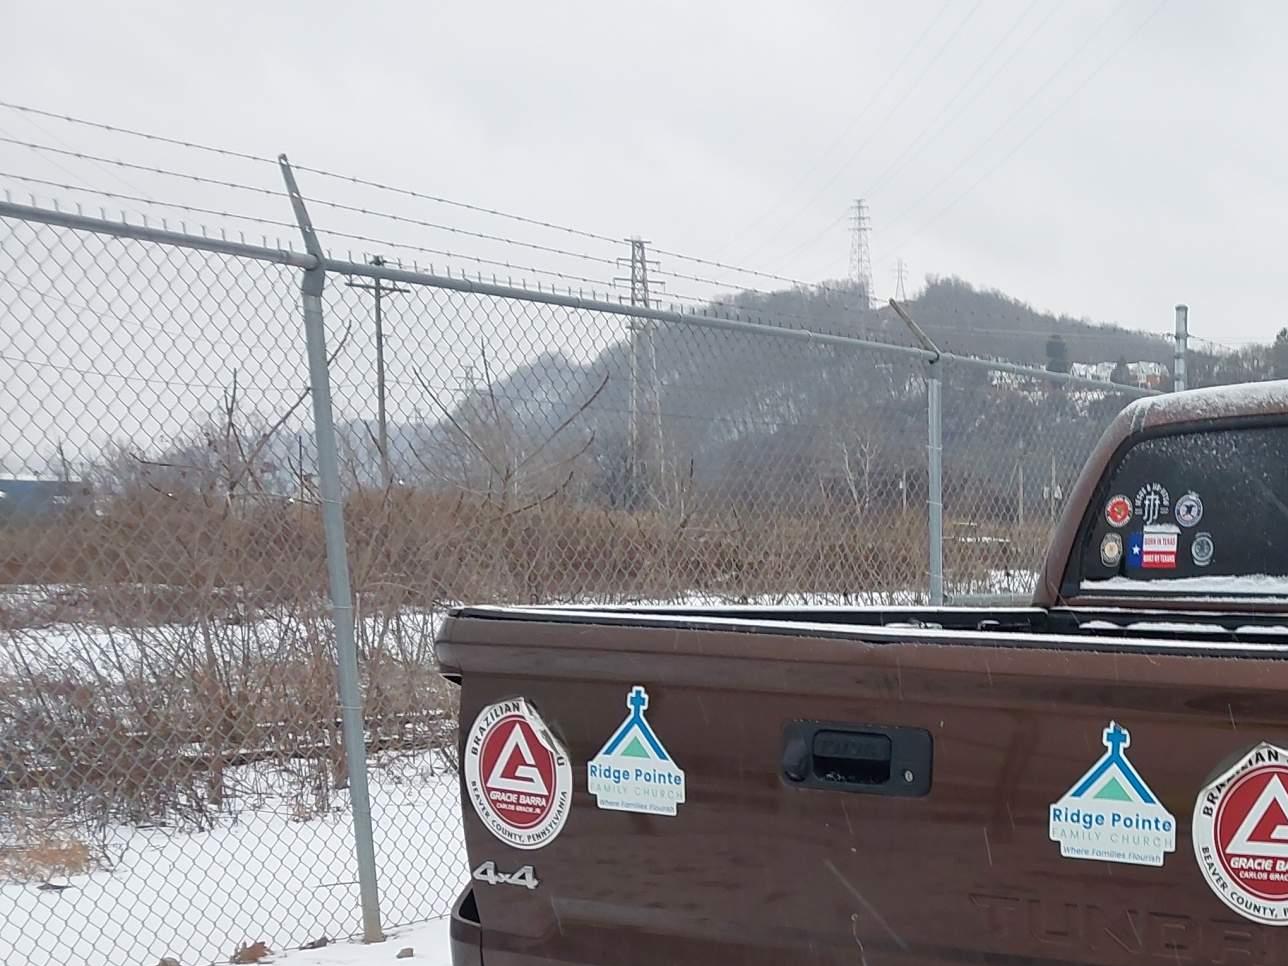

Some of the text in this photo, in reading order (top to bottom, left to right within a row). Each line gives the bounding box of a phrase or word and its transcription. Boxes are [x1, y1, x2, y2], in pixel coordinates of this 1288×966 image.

[472, 702, 521, 756] BRAZILIAN
[590, 764, 682, 785] Ridge Pointe
[489, 790, 547, 808] GRACIE BARRA
[635, 786, 683, 800] CHURCH
[471, 781, 568, 843] BEAVER COUNTY, PENNSYLVANIA
[1052, 807, 1172, 832] Ridge Pointe
[1052, 827, 1173, 848] FAMILY CHURCH
[1230, 857, 1272, 871] GRACIE
[1201, 846, 1228, 892] BEAVER
[1230, 891, 1279, 918] COUNTY,
[1239, 870, 1267, 880] CARLOS
